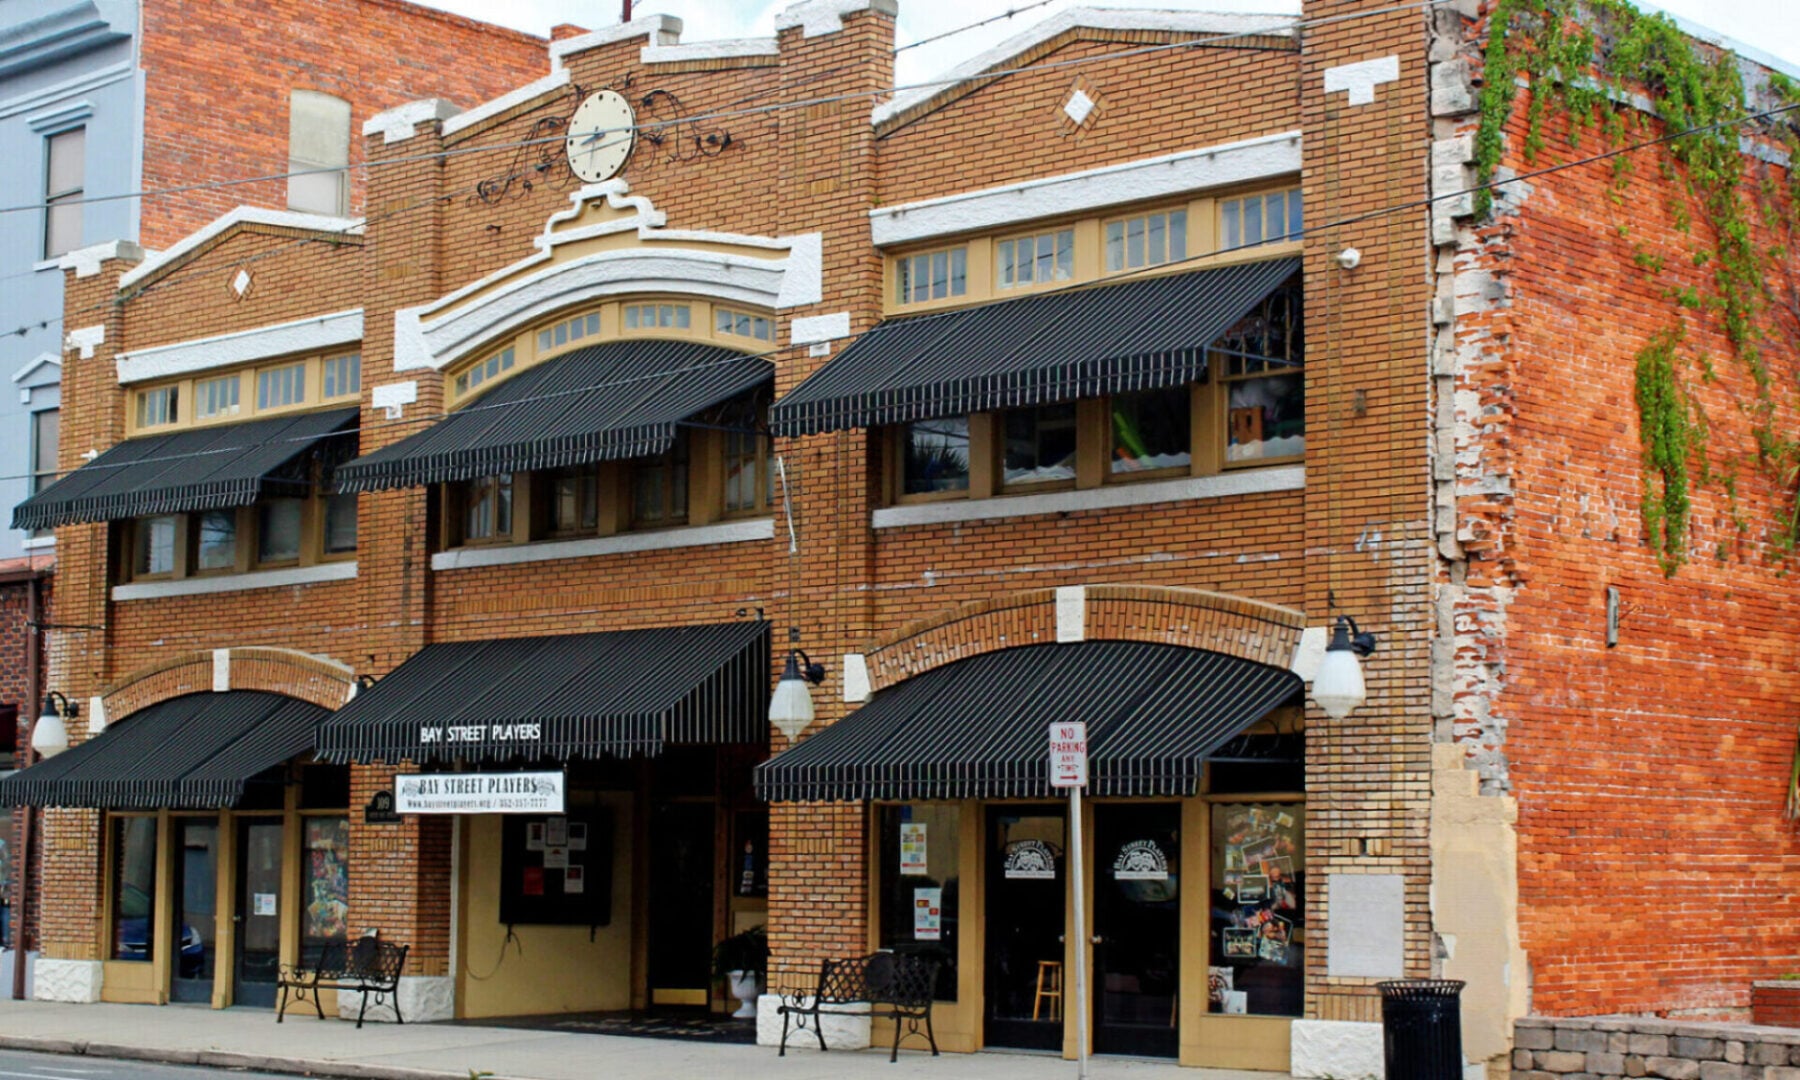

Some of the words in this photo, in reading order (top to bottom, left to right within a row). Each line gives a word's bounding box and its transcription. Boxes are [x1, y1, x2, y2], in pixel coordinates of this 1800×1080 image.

[420, 727, 443, 743] BAY
[447, 725, 487, 742] STREET
[492, 723, 541, 740] PLAYERS
[1060, 727, 1075, 739] NO
[1050, 742, 1086, 753] PARKING
[1061, 754, 1075, 763] ANY
[1060, 765, 1077, 773] TIME
[420, 778, 440, 794] BAY
[444, 777, 483, 794] STREET
[487, 776, 538, 793] PLAYERS
